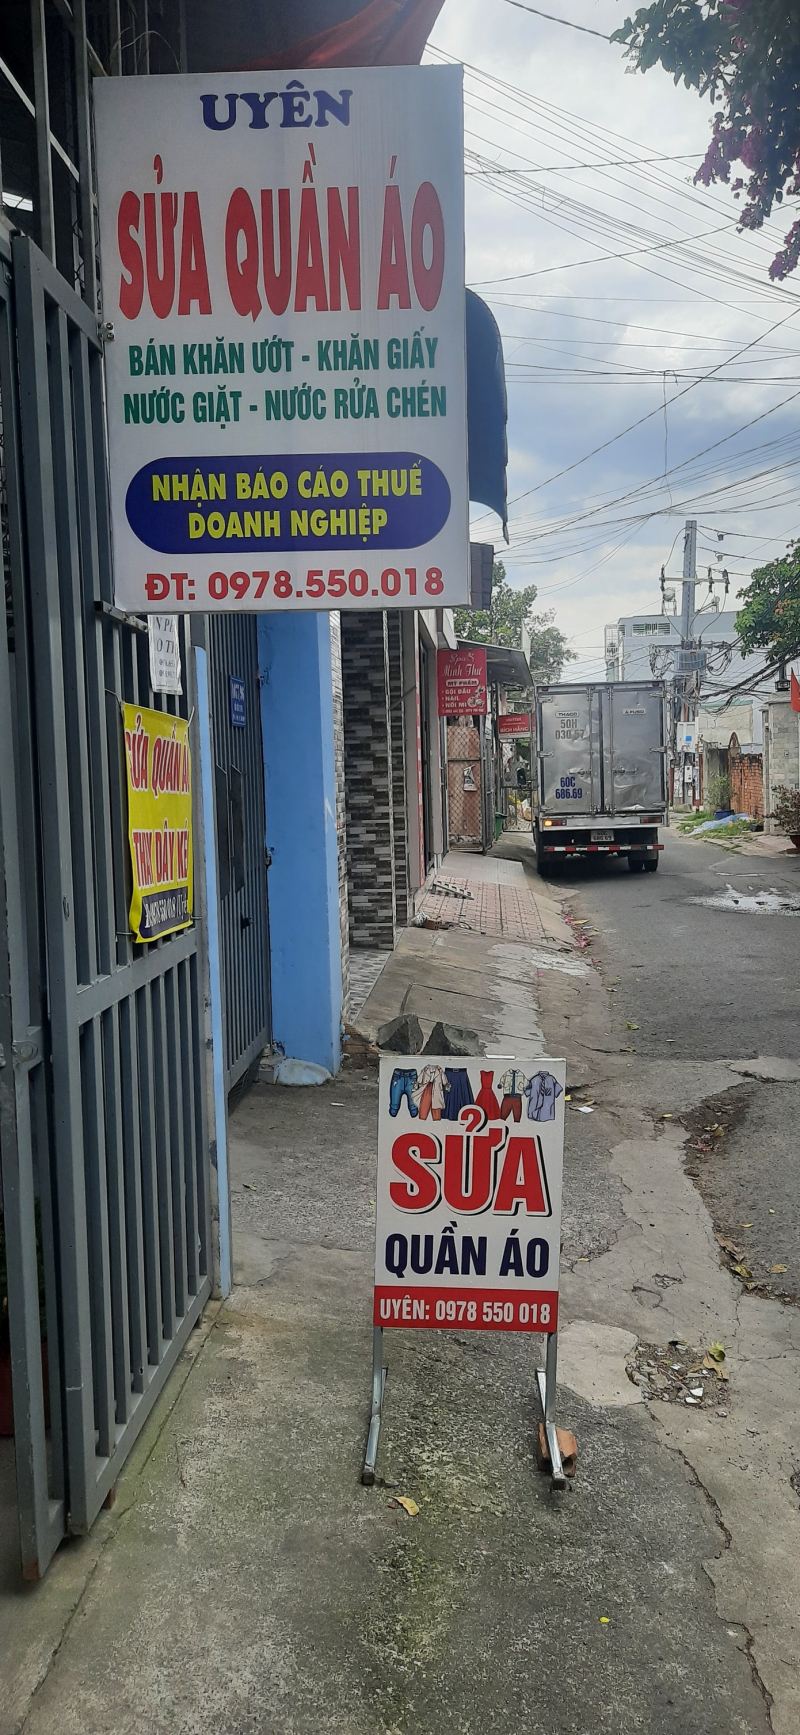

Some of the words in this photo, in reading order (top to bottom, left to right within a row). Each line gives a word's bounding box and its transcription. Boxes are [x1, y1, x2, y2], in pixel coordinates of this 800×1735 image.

[200, 79, 353, 131] UYÊN
[117, 154, 213, 320] SỬA
[225, 142, 362, 323] QUẦN
[377, 155, 445, 312] ÁO
[128, 338, 175, 376] BÁN
[182, 336, 245, 375] KHĂN
[252, 334, 295, 373] ƯỚT
[317, 333, 380, 371] KHĂN
[387, 326, 439, 370] GIẤY
[123, 386, 185, 425] NƯỚC
[192, 384, 242, 429] GIẶT
[265, 382, 327, 421] NƯỚC
[334, 377, 380, 419] RỬA
[386, 379, 447, 418] CHÉN
[151, 468, 227, 507] NHẬN
[236, 466, 289, 500] BÁO
[297, 464, 349, 499] CÁO
[357, 459, 422, 497] THUẾ
[188, 510, 281, 540] DOANH
[290, 503, 388, 542] NGHIỆP
[144, 573, 196, 601] ĐT:
[207, 567, 445, 600] 0978.550.018
[560, 719, 577, 729] 50H
[555, 788, 583, 800] 686.69
[560, 777, 576, 788] 60C
[155, 820, 175, 883] DÂY
[389, 1106, 551, 1217] SỬA
[385, 1220, 488, 1279] QUẦN
[499, 1228, 550, 1278] ÁO
[379, 1294, 431, 1321] UYÊN:
[435, 1300, 478, 1322] 0978
[482, 1302, 514, 1323] 550
[518, 1303, 551, 1325] 018
